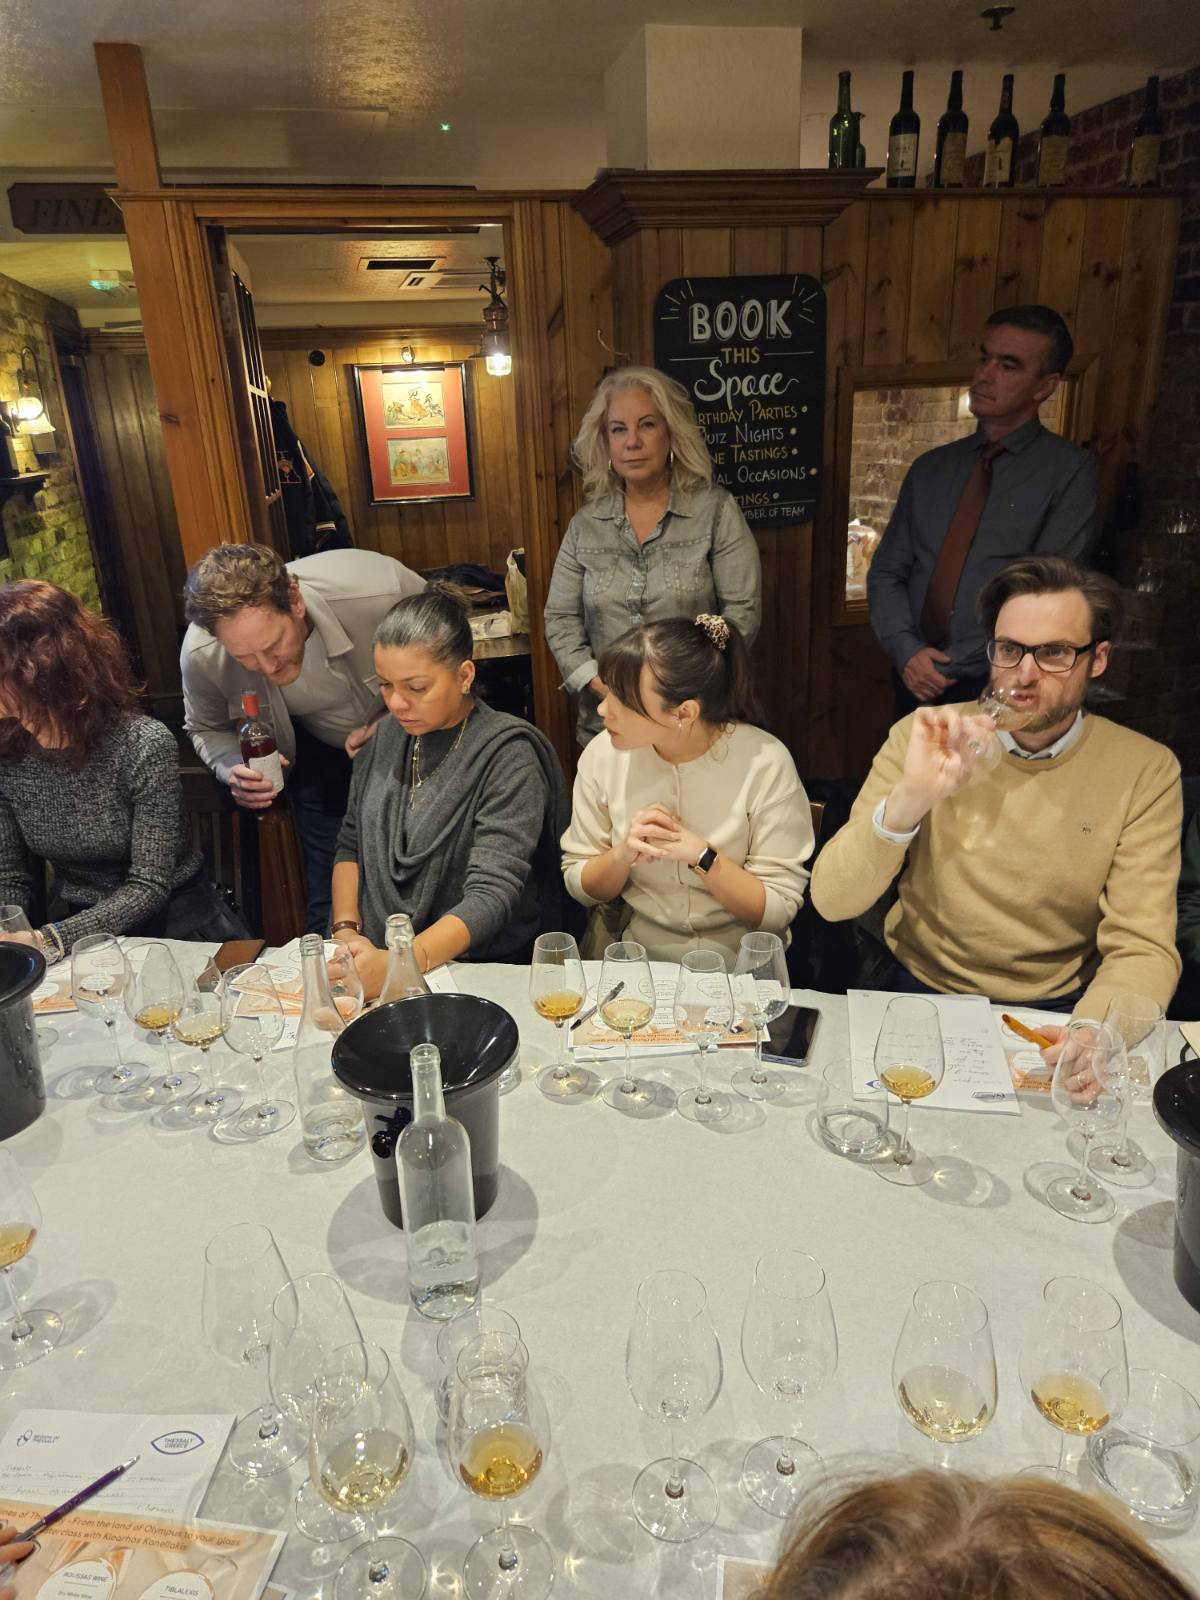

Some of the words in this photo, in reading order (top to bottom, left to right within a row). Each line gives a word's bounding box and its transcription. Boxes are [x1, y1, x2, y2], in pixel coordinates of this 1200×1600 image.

[688, 299, 792, 344] BOOK
[720, 347, 760, 364] THIS
[694, 359, 799, 410] Space
[698, 409, 744, 425] RTHDAY
[748, 399, 798, 421] PARTIES
[735, 423, 784, 444] NIGHTS
[730, 444, 788, 464] TASTINGS
[737, 465, 806, 484] OCCASIONS
[781, 506, 805, 518] TEAM
